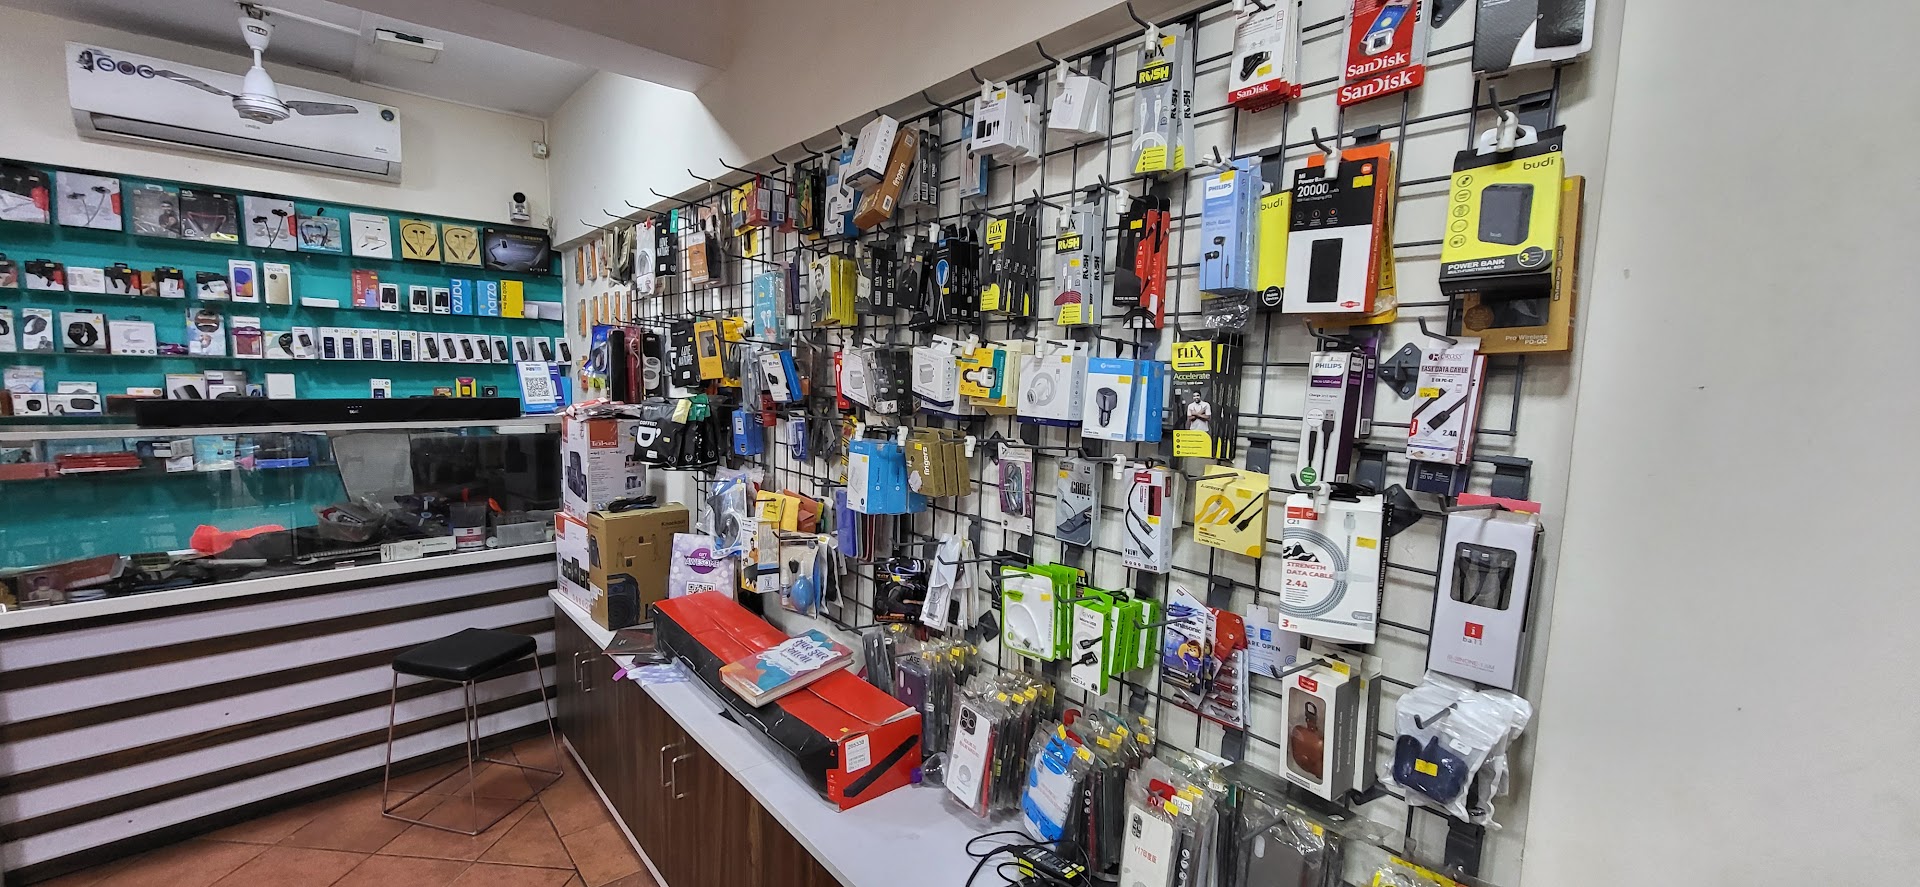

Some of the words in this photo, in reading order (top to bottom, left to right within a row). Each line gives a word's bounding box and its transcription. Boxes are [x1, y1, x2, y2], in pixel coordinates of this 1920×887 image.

[1347, 53, 1407, 77] SanDisk
[1139, 66, 1169, 83] RUSH
[1236, 84, 1269, 99] SanDisk
[1341, 71, 1412, 102] SanDisk
[1523, 157, 1554, 170] budi
[892, 163, 906, 187] fingers
[1208, 183, 1232, 192] PHILIPS
[1297, 183, 1329, 198] 20000
[1058, 237, 1080, 250] RUSH
[1520, 252, 1530, 263] 3
[1448, 261, 1478, 270] POWER
[1481, 259, 1505, 267] BANK
[451, 279, 463, 313] narzo
[487, 283, 498, 315] narzo
[1173, 372, 1211, 381] Accelerate
[922, 446, 931, 476] fingers
[1286, 561, 1327, 571] STRENGTH
[1286, 569, 1308, 577] DATA
[1309, 571, 1334, 580] CABLE
[1281, 618, 1289, 628] 3
[1262, 643, 1281, 652] OPEN
